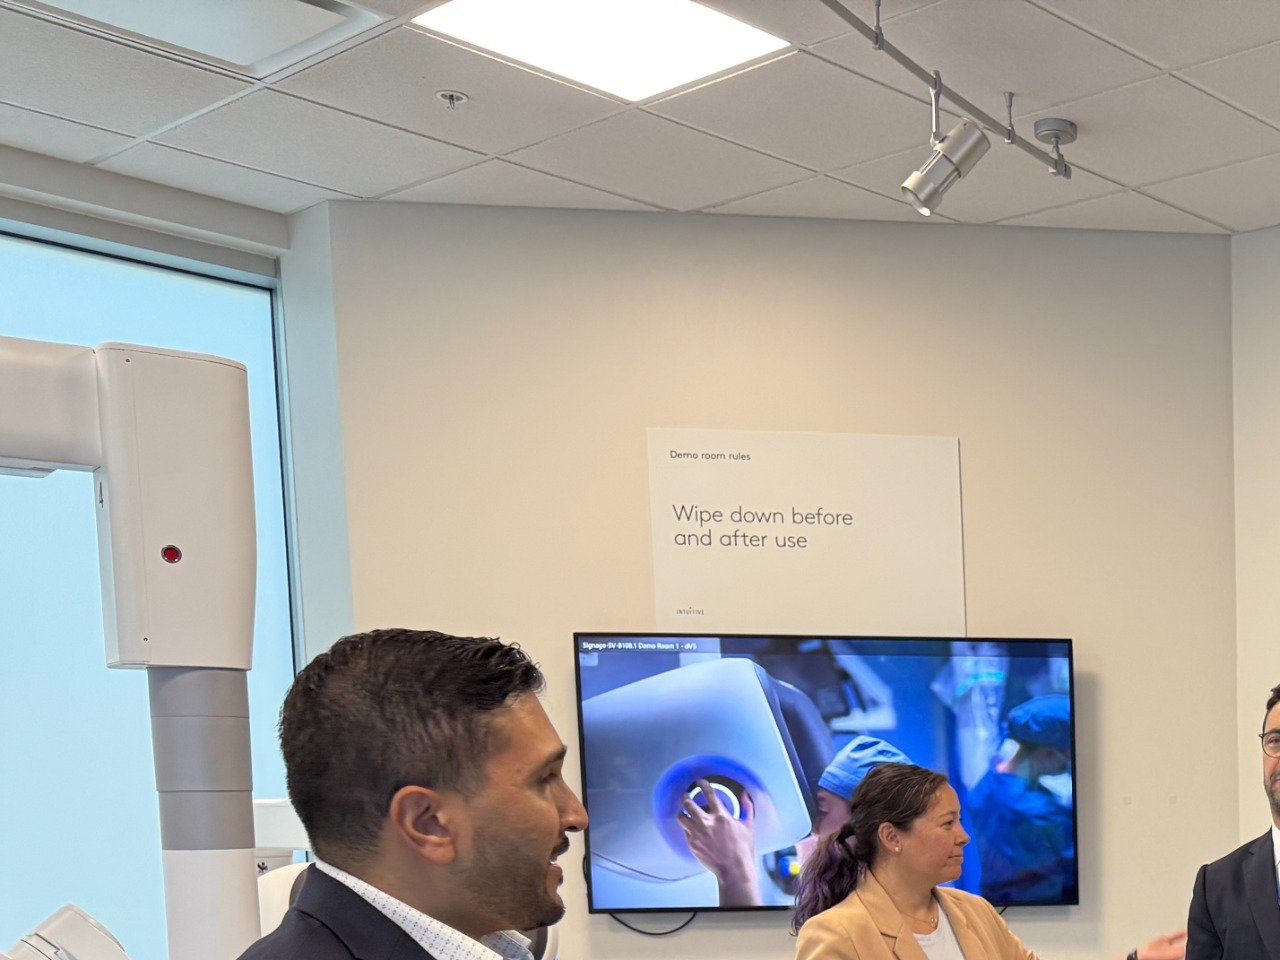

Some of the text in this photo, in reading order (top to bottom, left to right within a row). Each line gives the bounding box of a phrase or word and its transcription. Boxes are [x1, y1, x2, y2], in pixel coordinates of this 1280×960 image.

[670, 450, 698, 460] Demo
[729, 452, 751, 461] rules
[672, 504, 853, 526] Wipe down before
[674, 529, 808, 548] and after use
